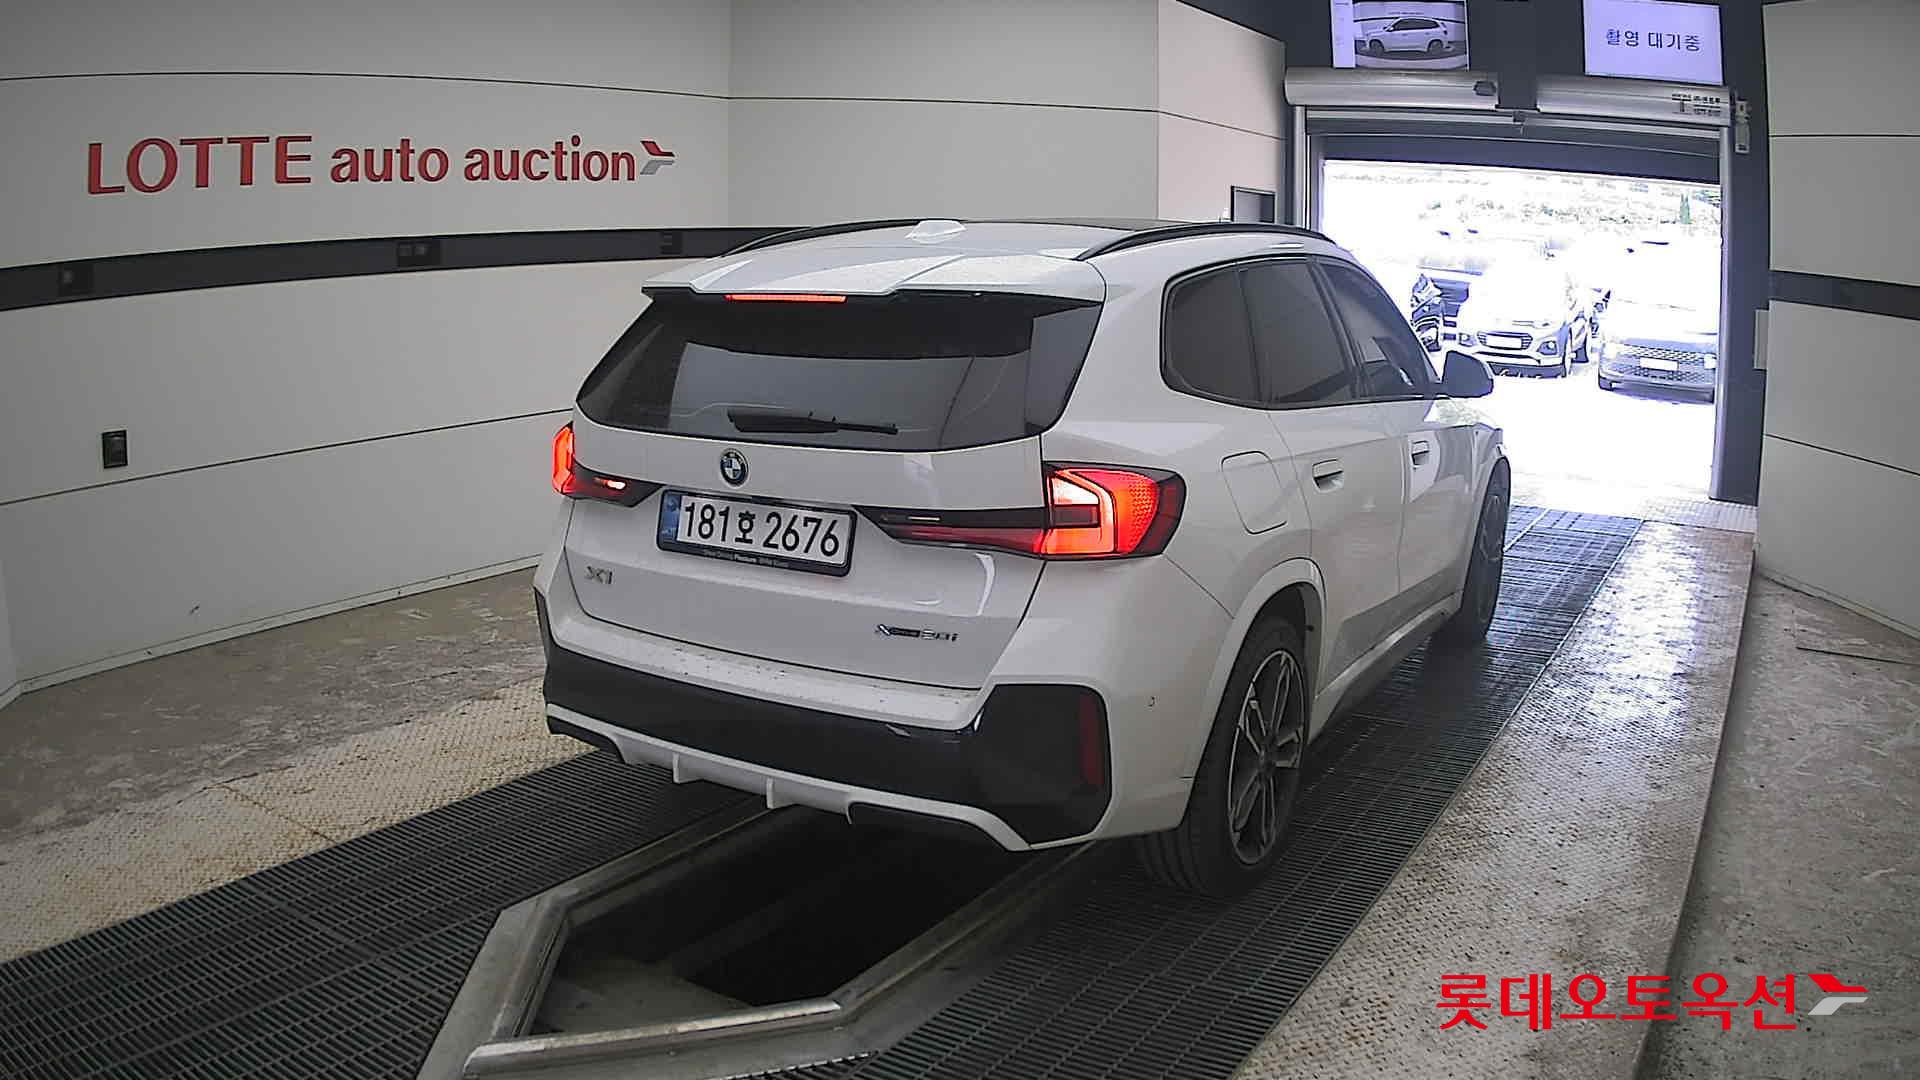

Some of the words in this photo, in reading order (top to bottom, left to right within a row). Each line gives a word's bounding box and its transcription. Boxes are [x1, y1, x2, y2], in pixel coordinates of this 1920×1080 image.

[1647, 32, 1700, 52] 대기중
[88, 136, 312, 195] LOTTE
[331, 139, 448, 182] auto
[464, 135, 635, 182] auction
[685, 502, 756, 544] 181호
[763, 512, 839, 557] 2676
